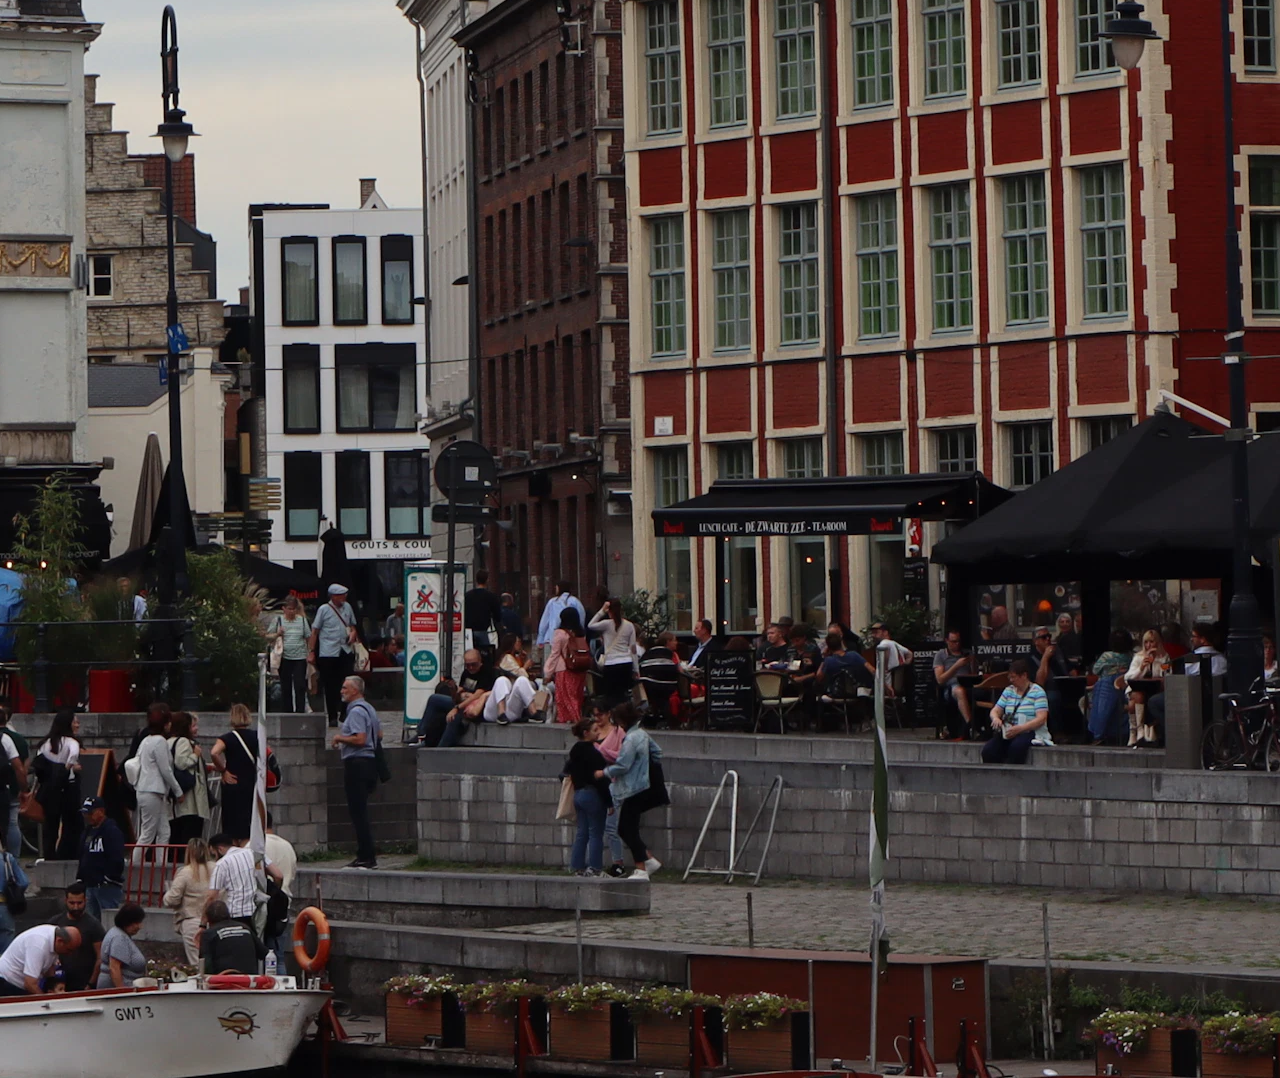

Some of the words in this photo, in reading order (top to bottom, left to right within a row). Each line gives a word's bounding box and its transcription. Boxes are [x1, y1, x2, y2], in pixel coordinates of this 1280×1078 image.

[699, 522, 720, 532] LUNCH
[745, 521, 756, 533] DE
[756, 520, 789, 534] ZWARTE
[790, 521, 806, 534] ZEE
[812, 521, 847, 532] TEA-ROOM
[351, 541, 388, 549] GOUTS
[392, 540, 399, 549] &
[977, 645, 1012, 654] ZWARTE
[114, 1007, 142, 1021] GWT
[145, 1006, 154, 1019] 3
